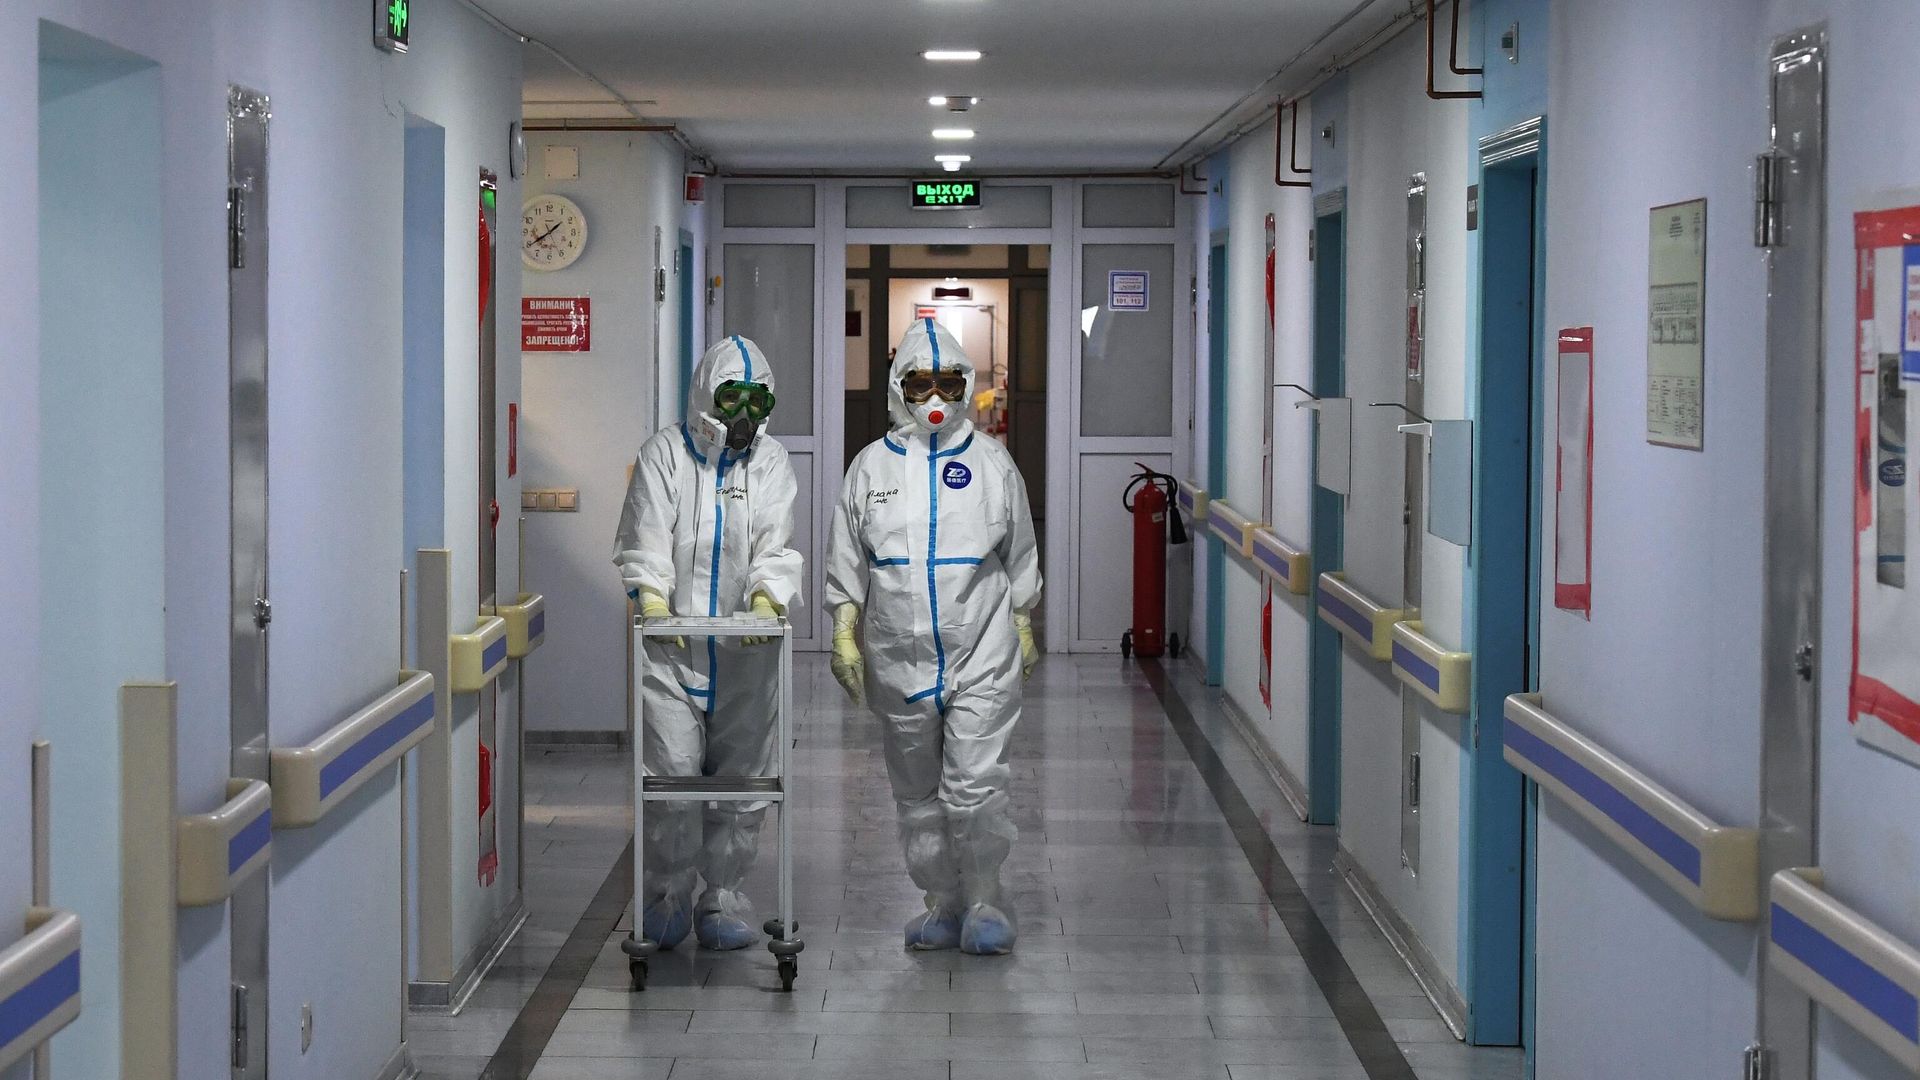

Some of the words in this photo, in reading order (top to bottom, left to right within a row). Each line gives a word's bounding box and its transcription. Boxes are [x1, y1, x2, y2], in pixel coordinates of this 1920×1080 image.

[917, 184, 974, 196] ВЫХОД
[925, 195, 966, 204] EXIT
[529, 300, 575, 310] ВНИМАНИЕ
[525, 335, 579, 346] ЗАПРЕЩЕНО!
